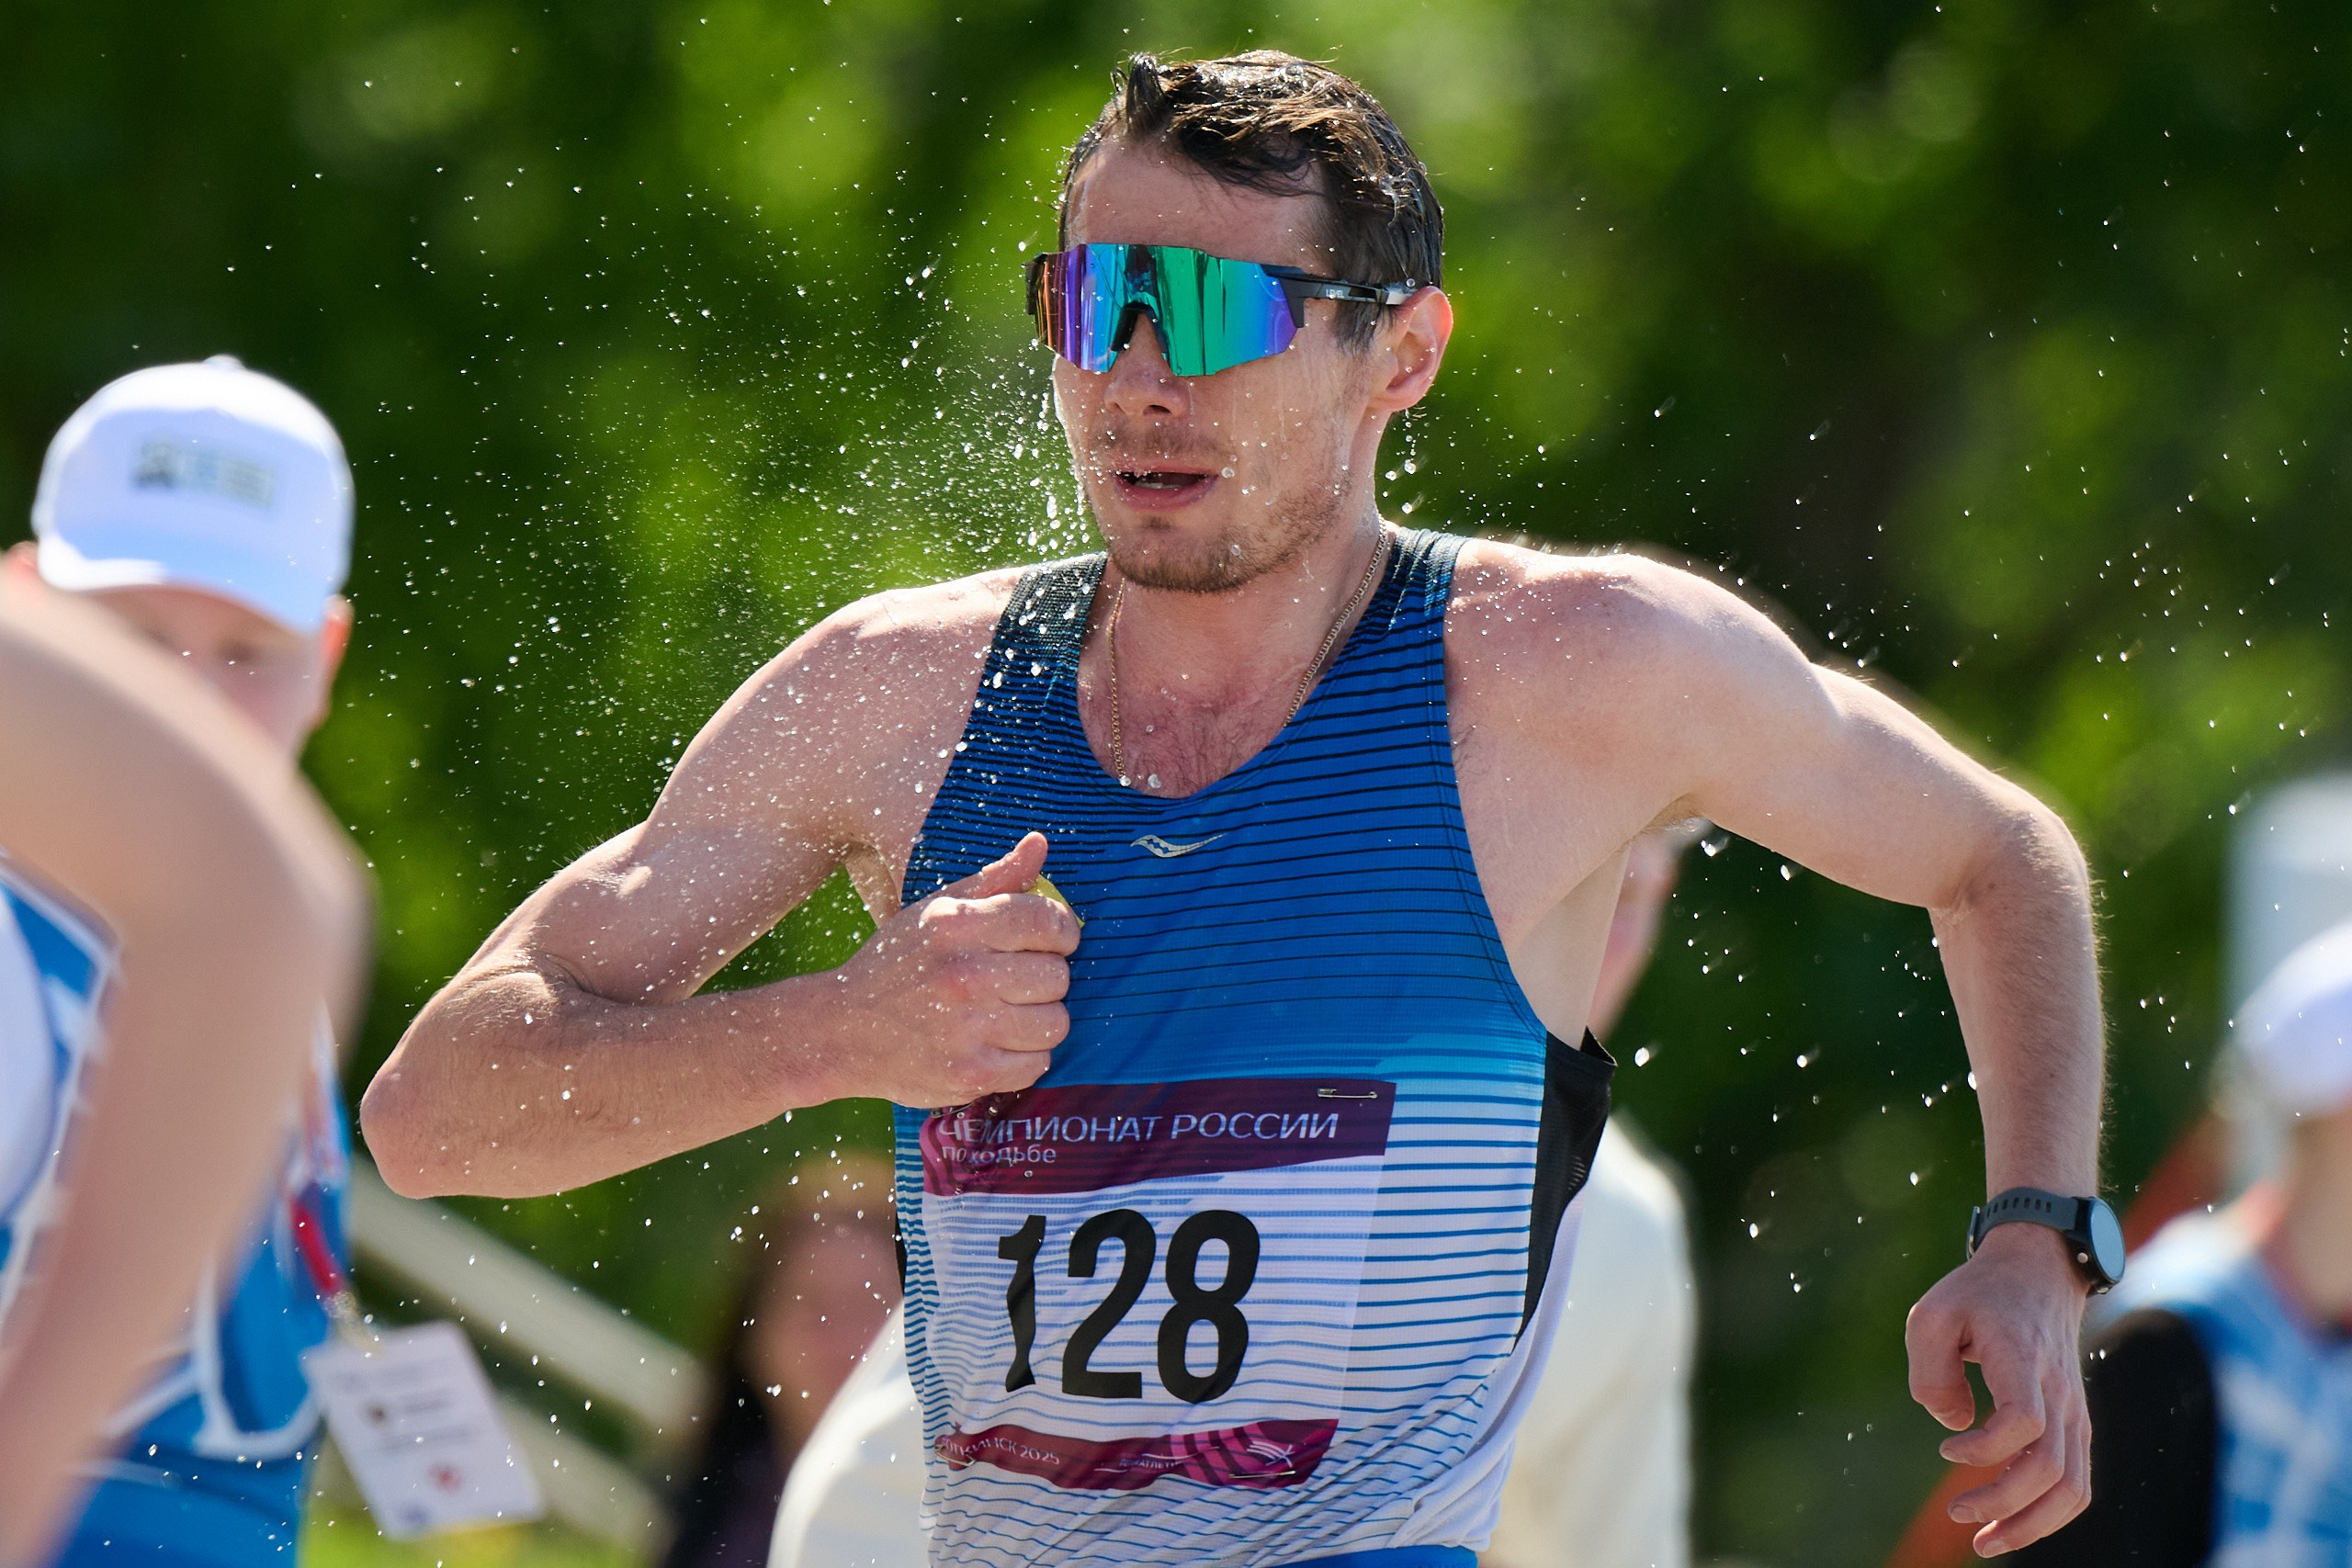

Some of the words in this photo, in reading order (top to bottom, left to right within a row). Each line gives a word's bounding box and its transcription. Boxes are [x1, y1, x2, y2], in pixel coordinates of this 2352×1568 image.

[938, 1111, 1162, 1145] ЧЕМПИОНАТ
[1170, 1111, 1340, 1140] РОССИИ
[941, 1145, 967, 1163] по
[968, 1143, 1057, 1168] ходьбе
[998, 1208, 1261, 1405] 128
[1019, 1444, 1060, 1466] 2025
